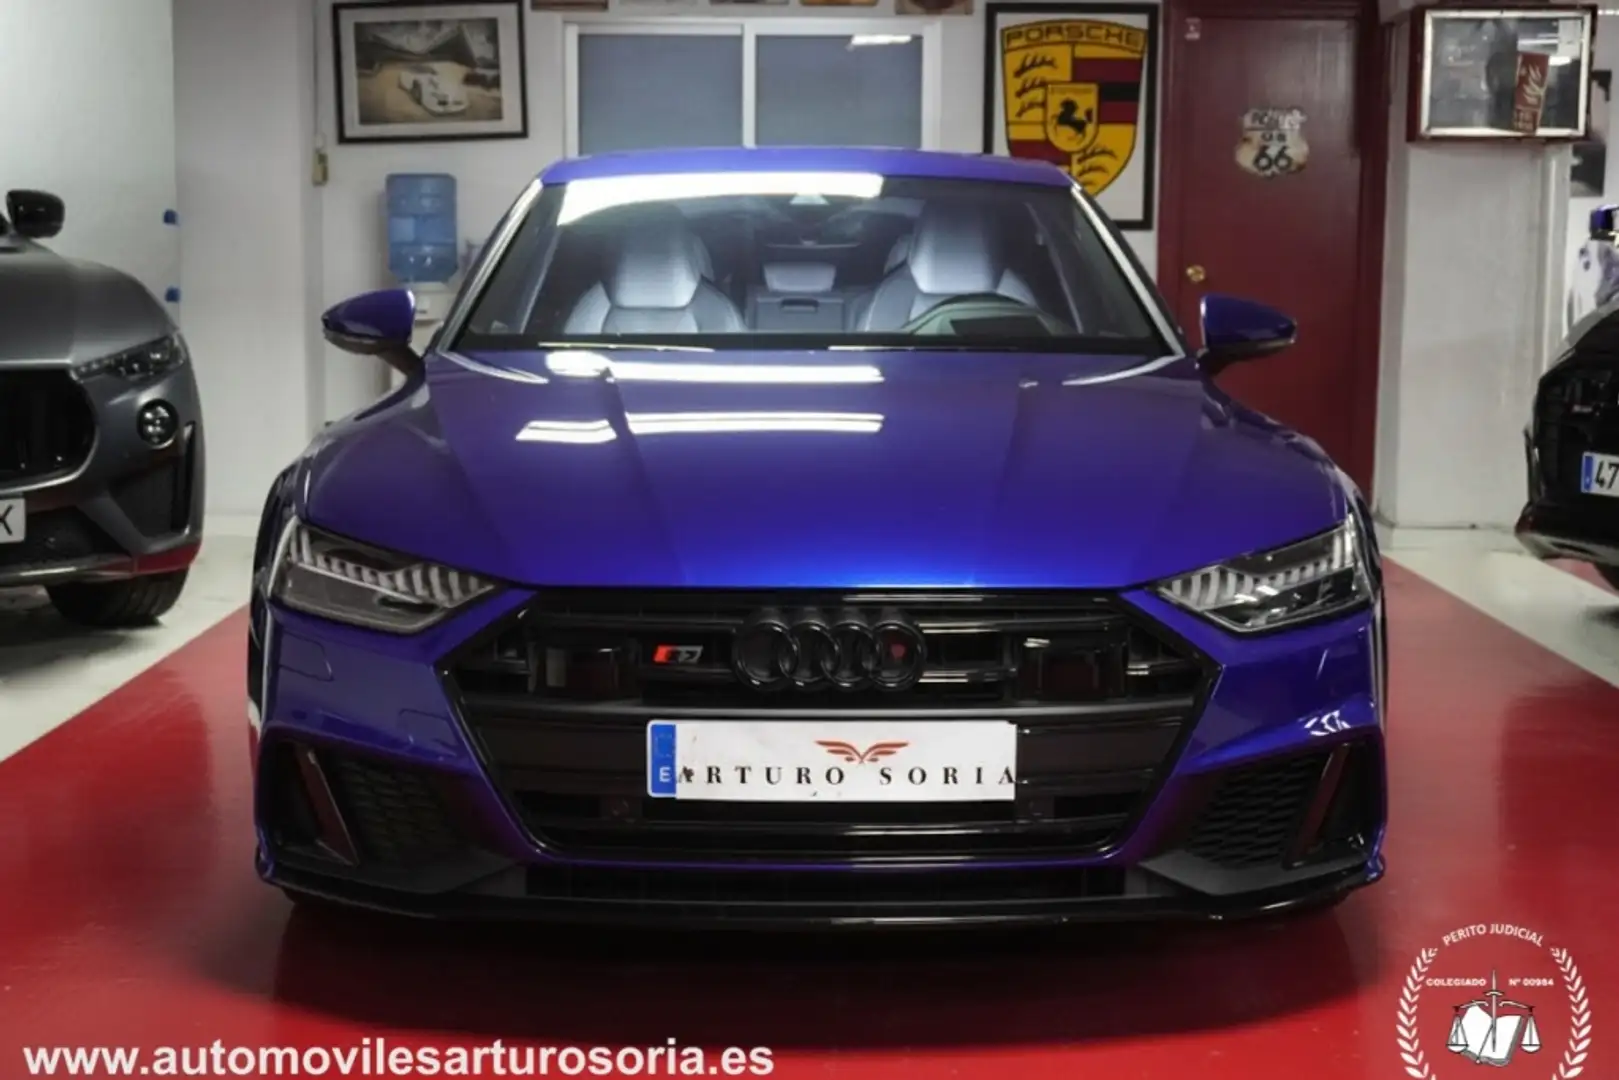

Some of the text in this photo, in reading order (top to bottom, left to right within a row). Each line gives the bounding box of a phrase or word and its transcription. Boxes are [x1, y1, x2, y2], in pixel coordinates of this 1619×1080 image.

[1005, 24, 1142, 48] PORSCHE
[1253, 145, 1294, 171] 66
[659, 766, 672, 783] E
[677, 765, 1016, 785] ARTURO SORIA
